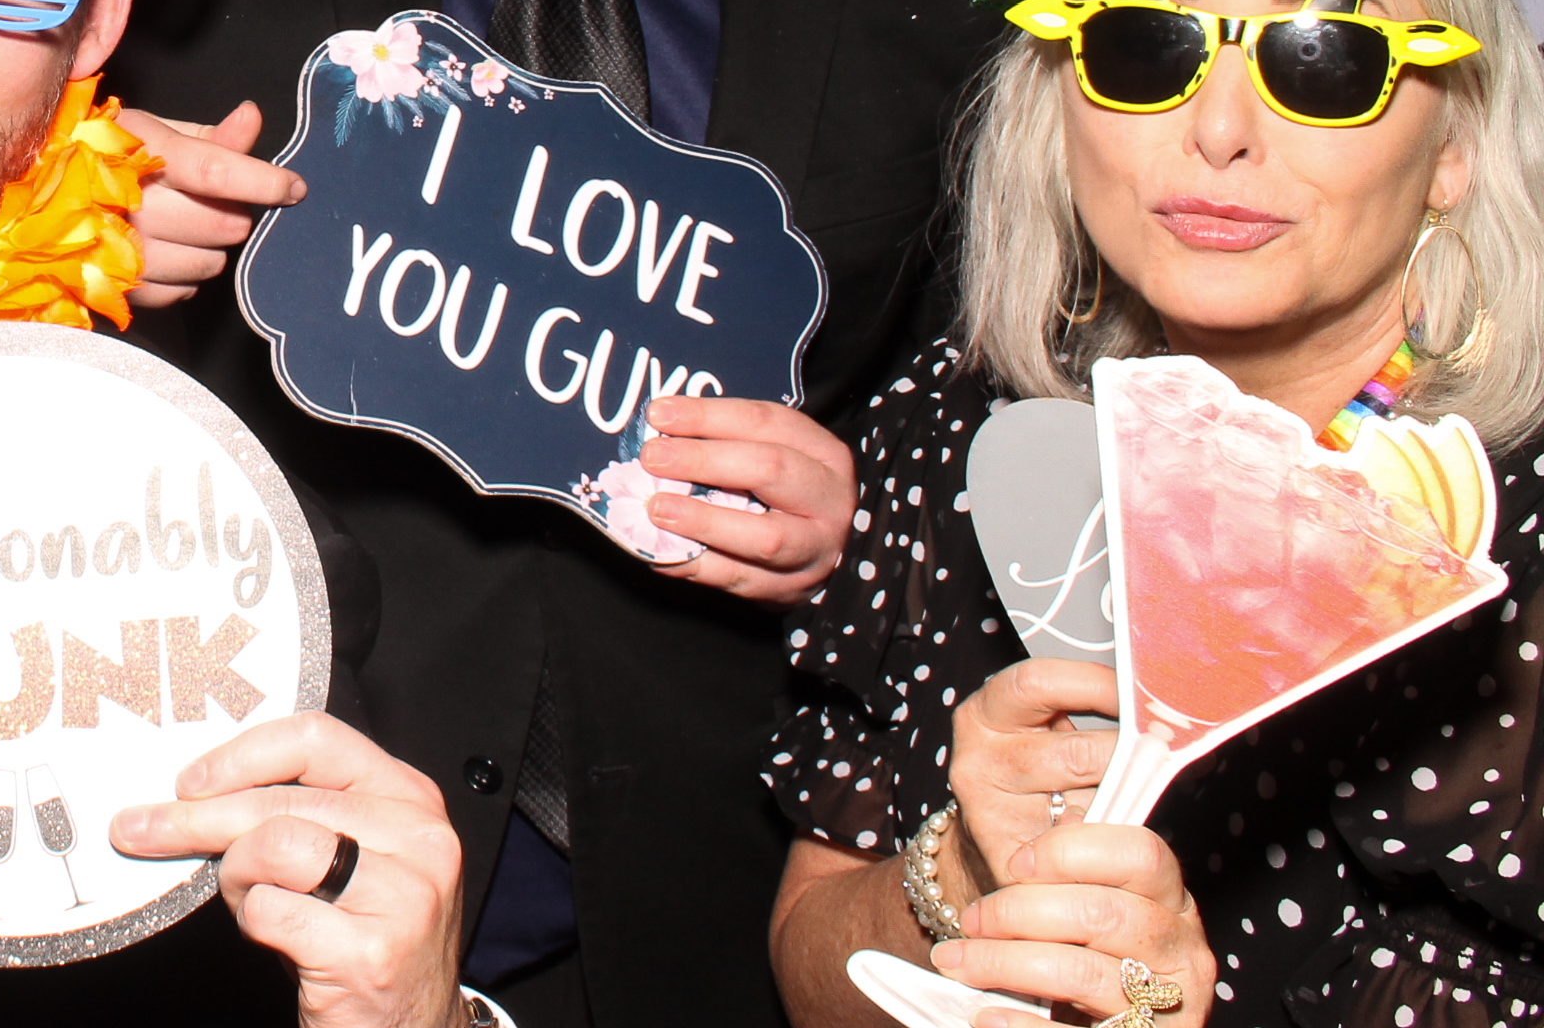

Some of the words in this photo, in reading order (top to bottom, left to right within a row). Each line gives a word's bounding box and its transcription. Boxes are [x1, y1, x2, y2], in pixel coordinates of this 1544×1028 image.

[343, 223, 509, 370] YOU
[421, 104, 462, 205] I
[511, 145, 734, 325] LOVE
